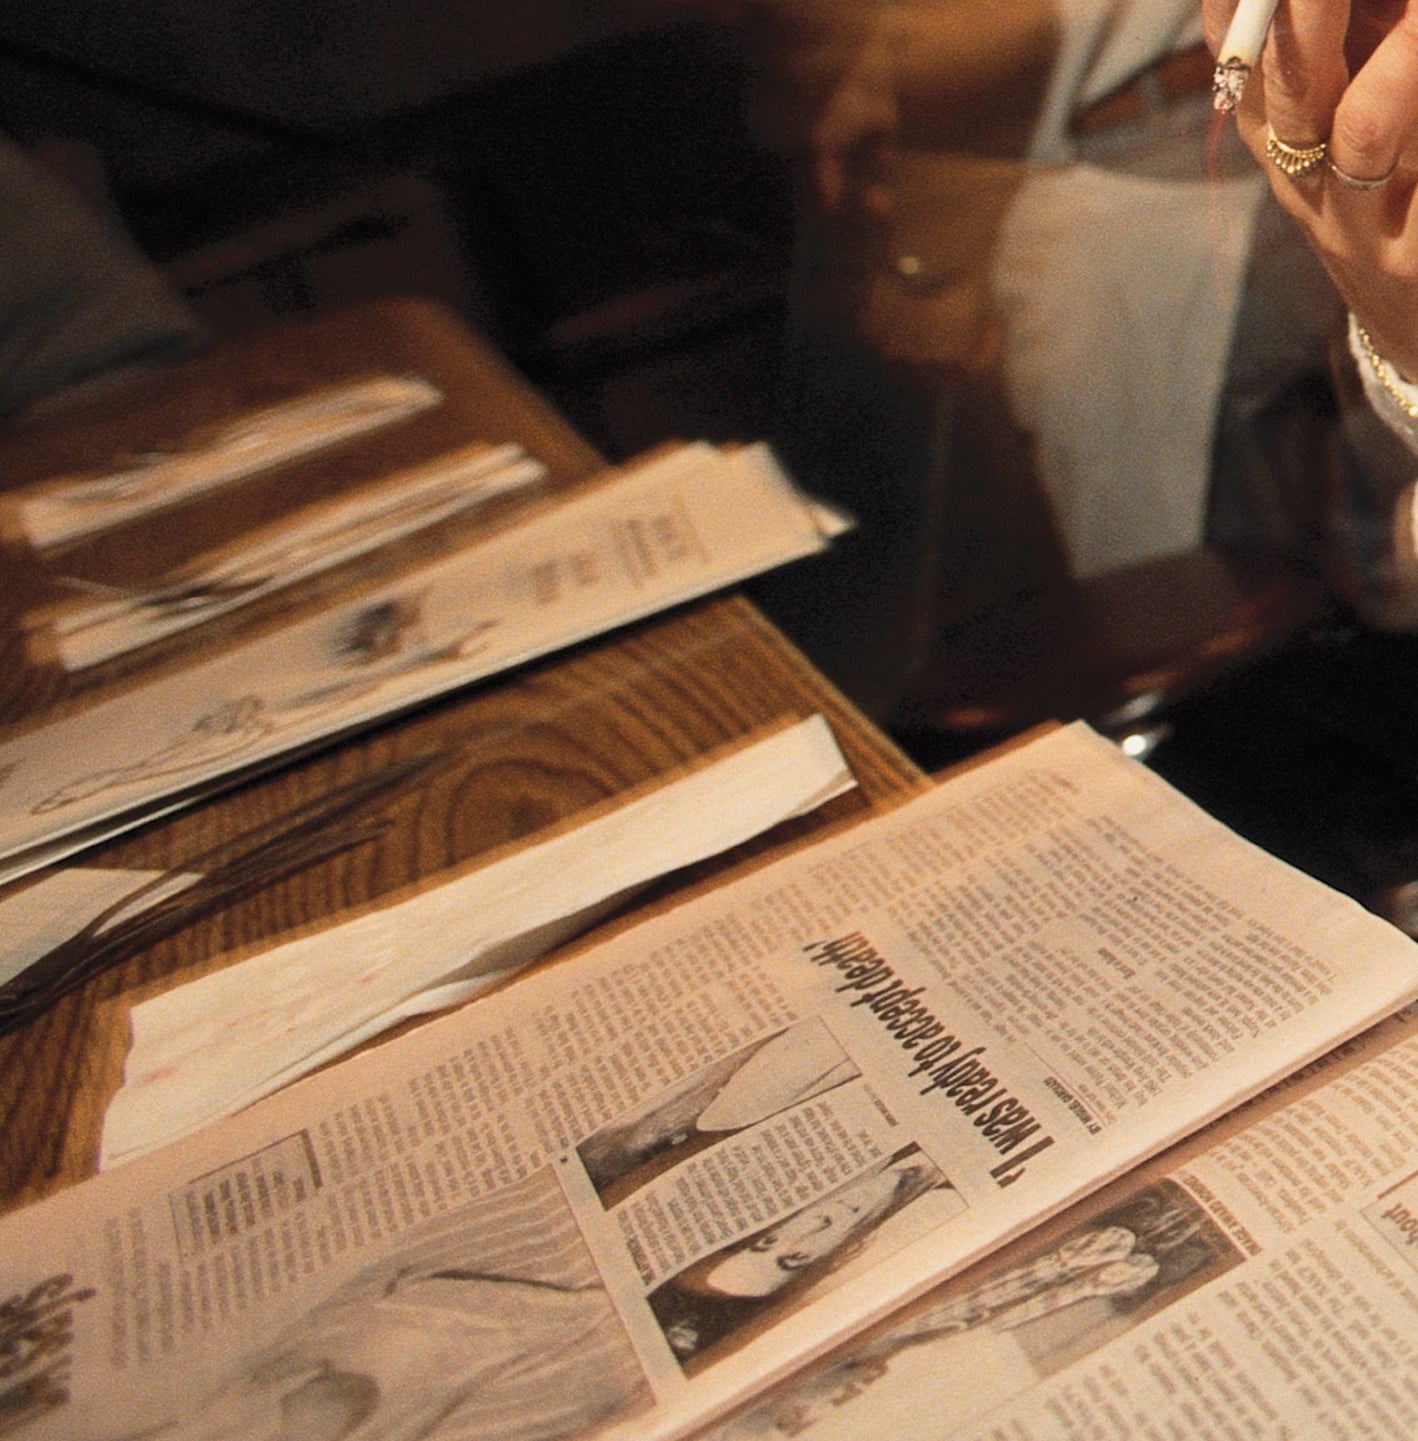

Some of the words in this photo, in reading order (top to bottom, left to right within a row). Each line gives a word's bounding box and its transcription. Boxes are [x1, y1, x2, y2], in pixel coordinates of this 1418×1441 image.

[802, 932, 894, 993] death'
[850, 980, 944, 1050] accept
[908, 1036, 961, 1078] to
[919, 1047, 1007, 1116] ready
[973, 1098, 1041, 1155] was
[1068, 1100, 1092, 1125] MIGUEL
[1087, 1123, 1102, 1135] BY
[989, 1136, 1055, 1189] 'I
